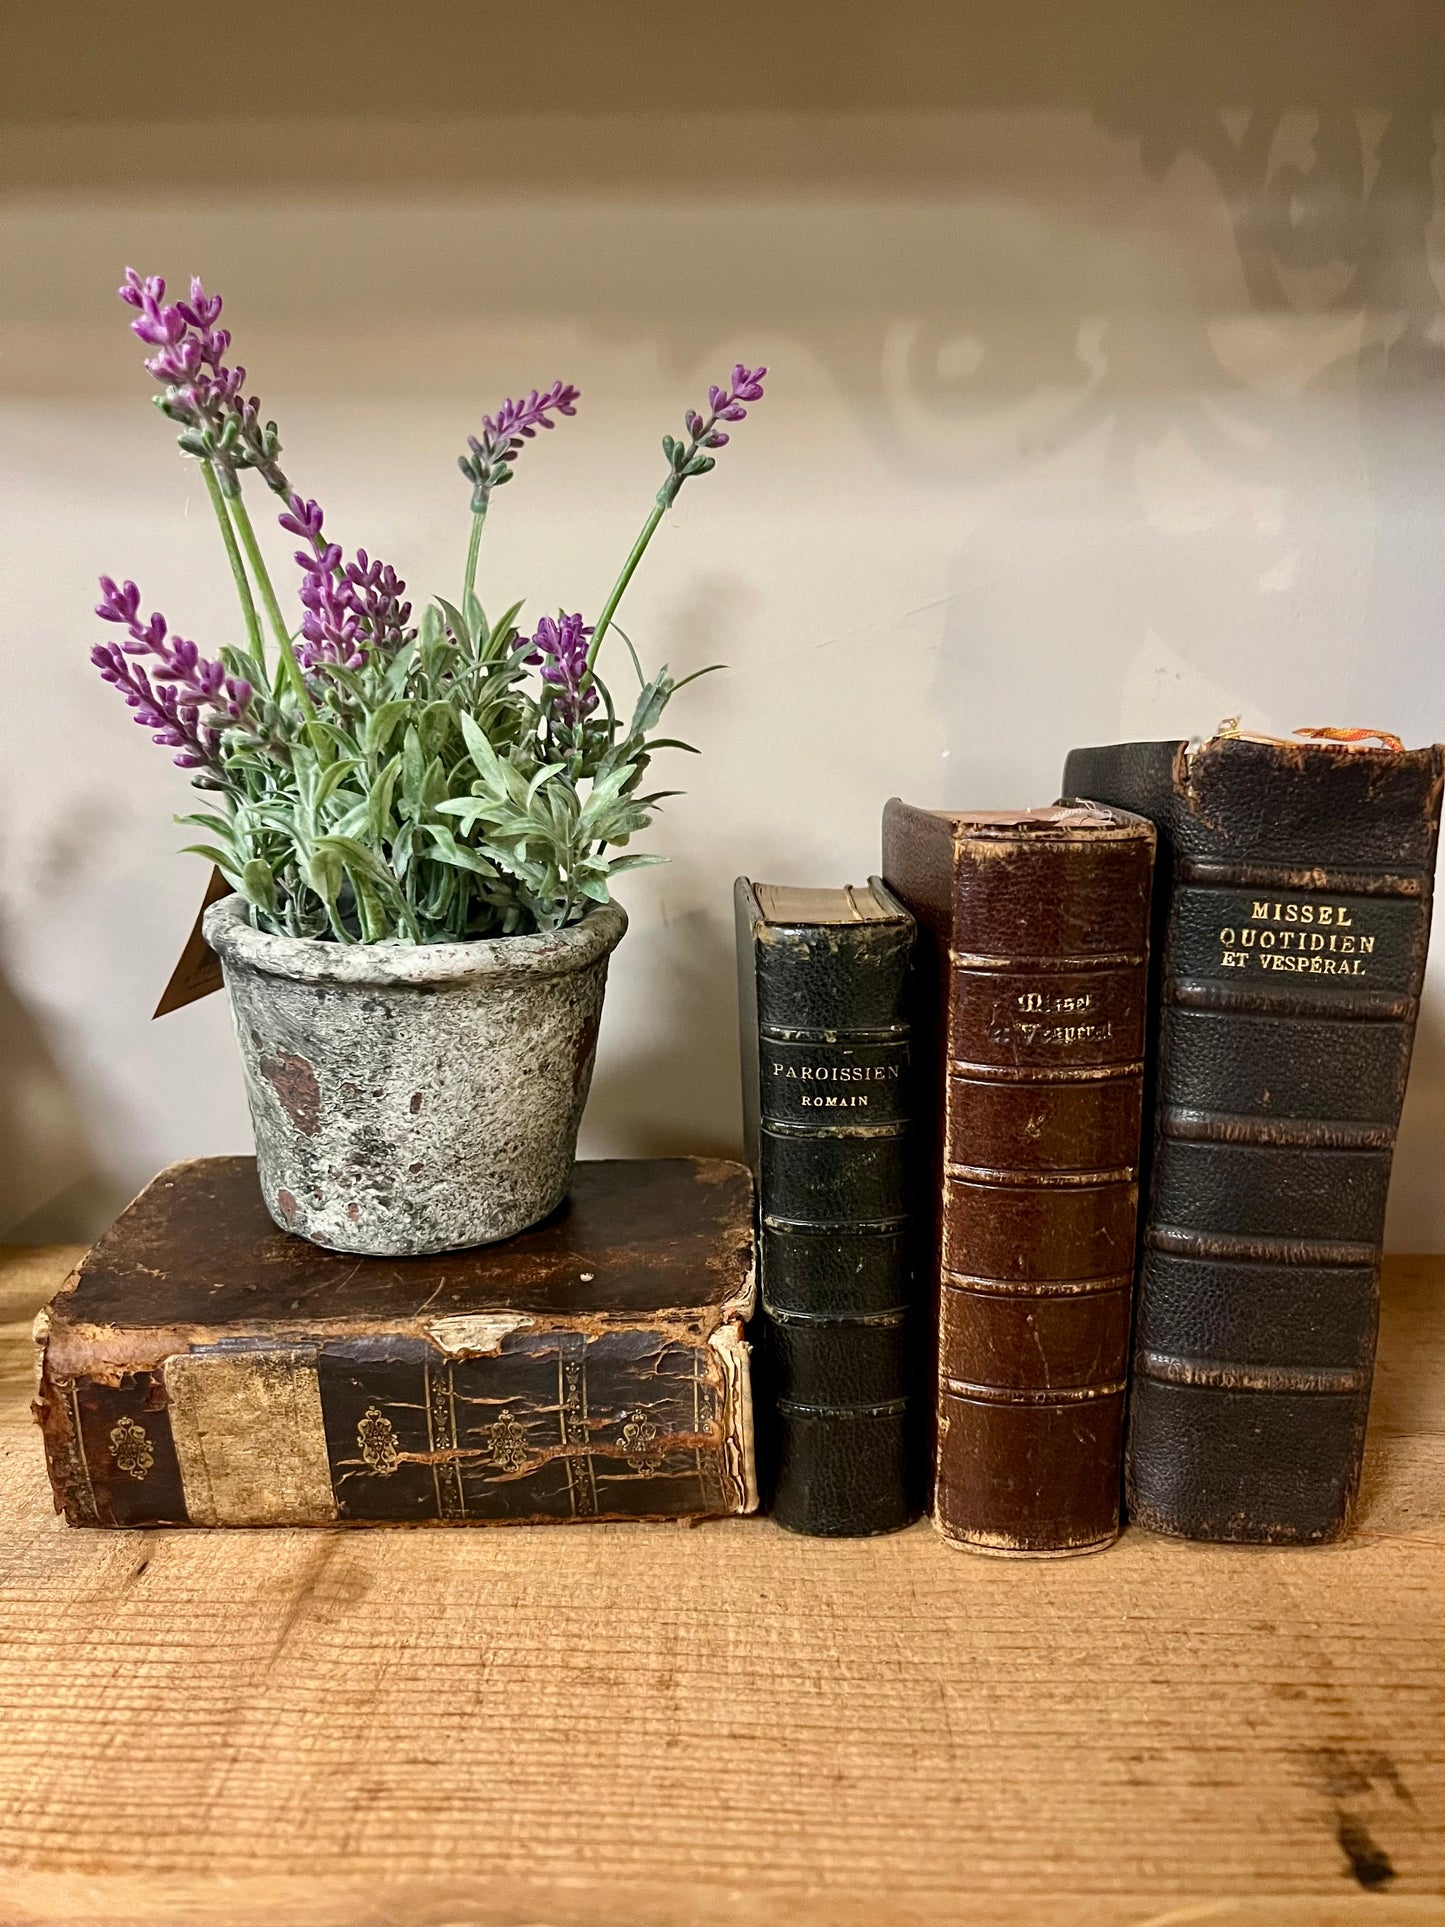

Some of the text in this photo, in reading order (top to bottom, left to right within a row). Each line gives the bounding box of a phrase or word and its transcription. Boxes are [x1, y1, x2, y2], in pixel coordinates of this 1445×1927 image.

[1251, 901, 1353, 927] MISSEL
[1219, 927, 1376, 954] QUOTIDIEN
[1220, 950, 1366, 976] ET VESPÉRAL
[772, 1062, 900, 1082] PAROISSIEN
[801, 1095, 869, 1108] ROMAIN
